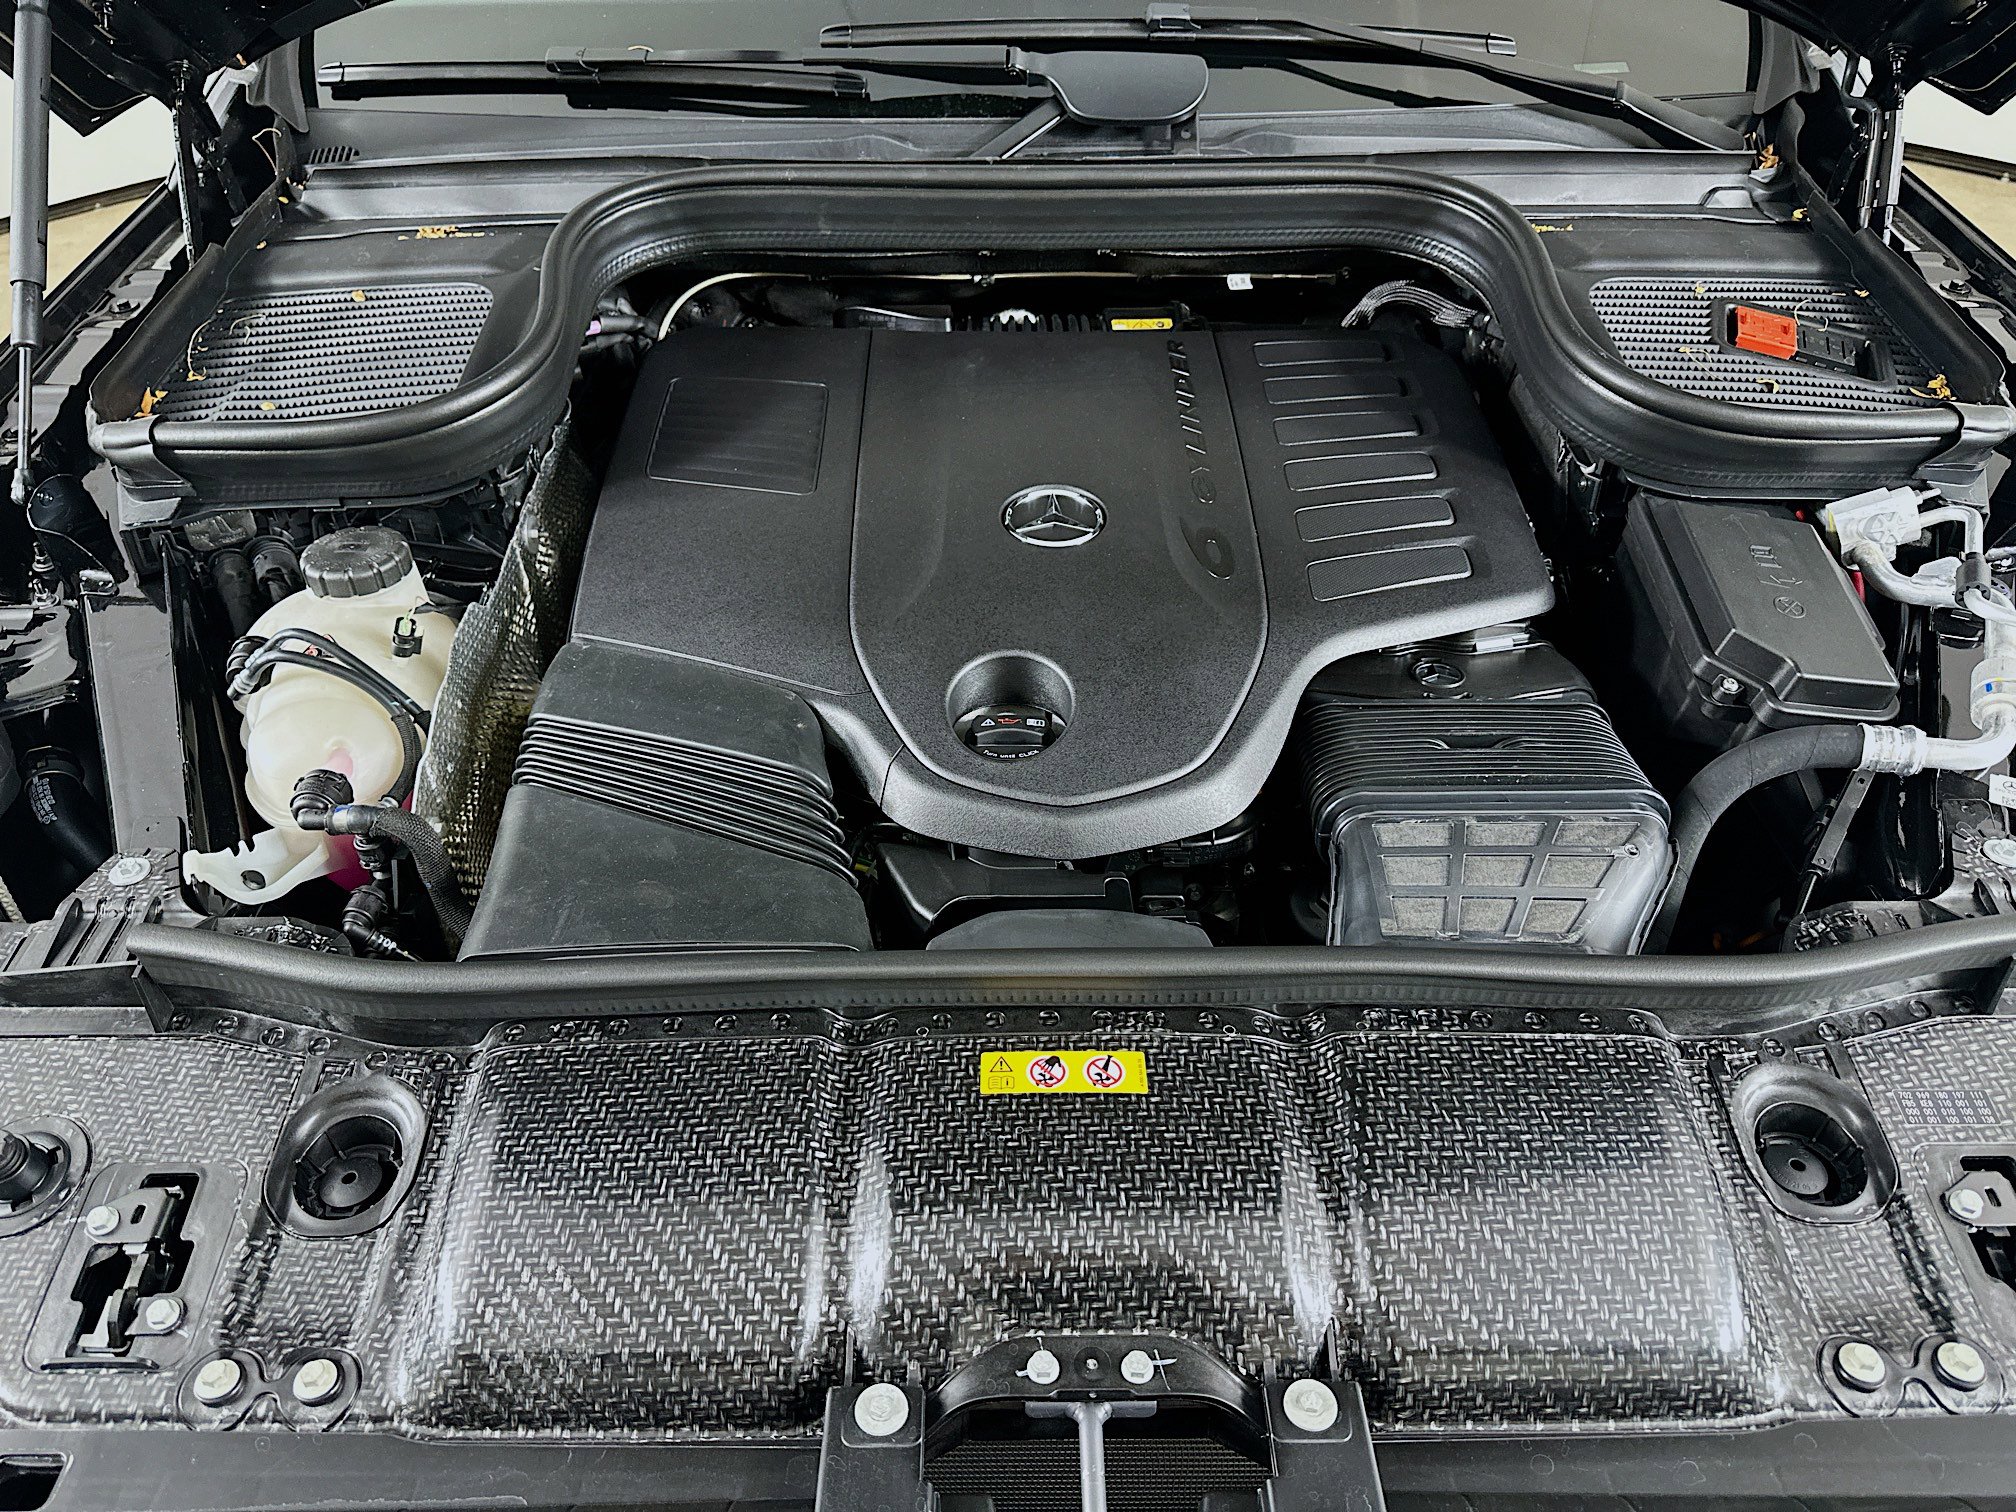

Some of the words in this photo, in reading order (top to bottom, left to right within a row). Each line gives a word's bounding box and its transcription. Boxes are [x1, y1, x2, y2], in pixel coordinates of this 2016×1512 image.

[1167, 340, 1218, 504] CYLINDER
[1898, 1091, 1913, 1099] 702
[1915, 1091, 1930, 1099] 969
[1934, 1091, 1949, 1099] 180
[1952, 1091, 1965, 1099] 197
[1970, 1091, 1984, 1099] 111
[1908, 1116, 1924, 1124] 011
[1927, 1116, 1941, 1124] 001
[1945, 1116, 1960, 1124] 100
[1963, 1116, 1977, 1124] 101
